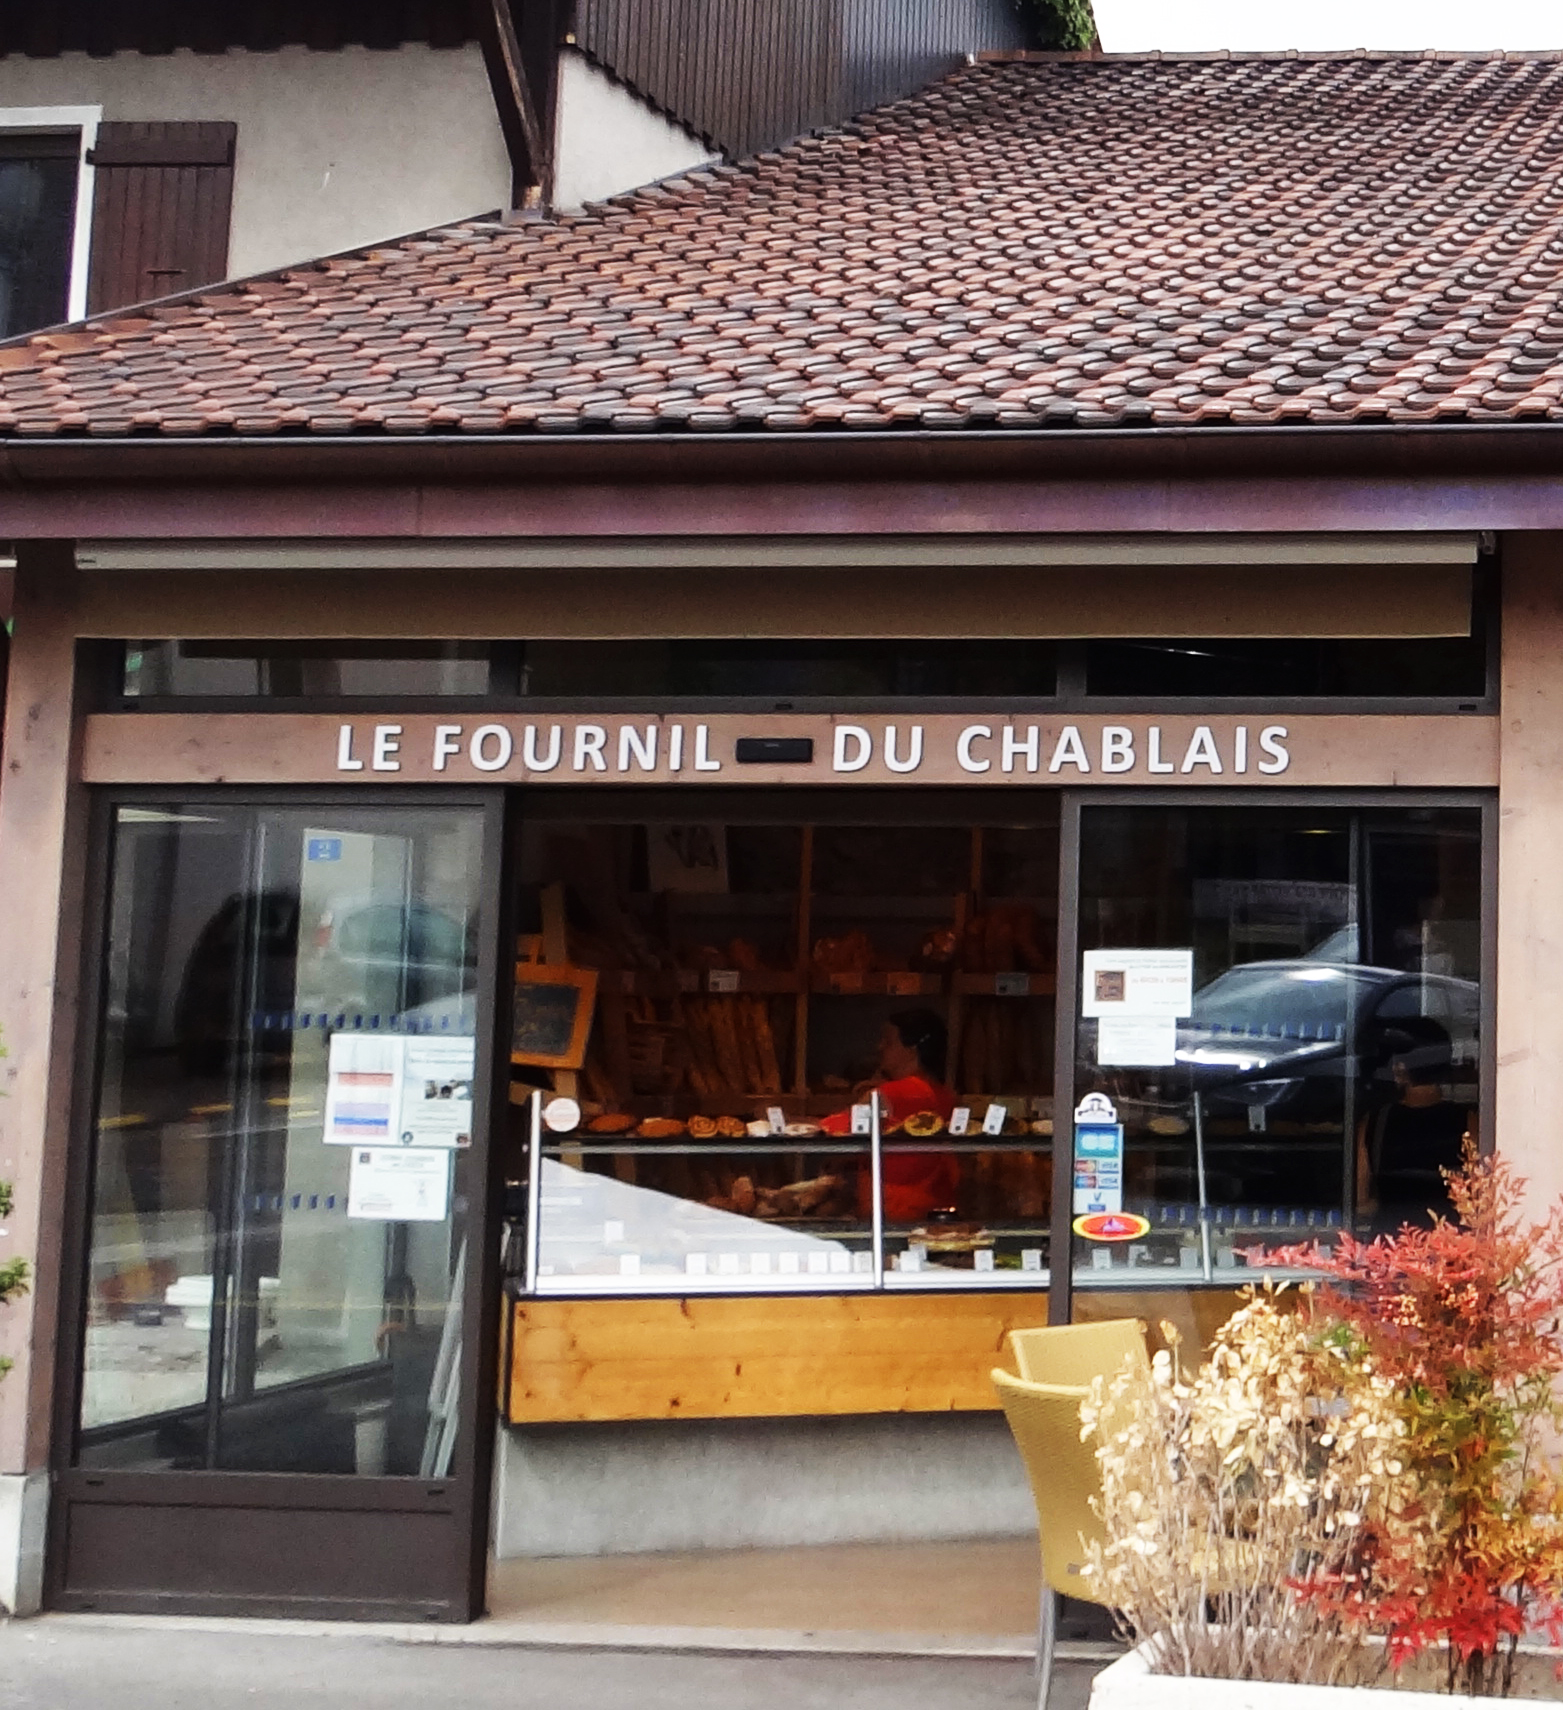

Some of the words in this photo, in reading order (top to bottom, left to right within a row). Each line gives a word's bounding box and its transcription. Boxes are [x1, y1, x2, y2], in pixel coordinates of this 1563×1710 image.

[336, 724, 402, 771] LE
[432, 724, 721, 772] FOURNIL
[832, 724, 923, 772] DU
[956, 724, 1290, 774] CHABLAIS
